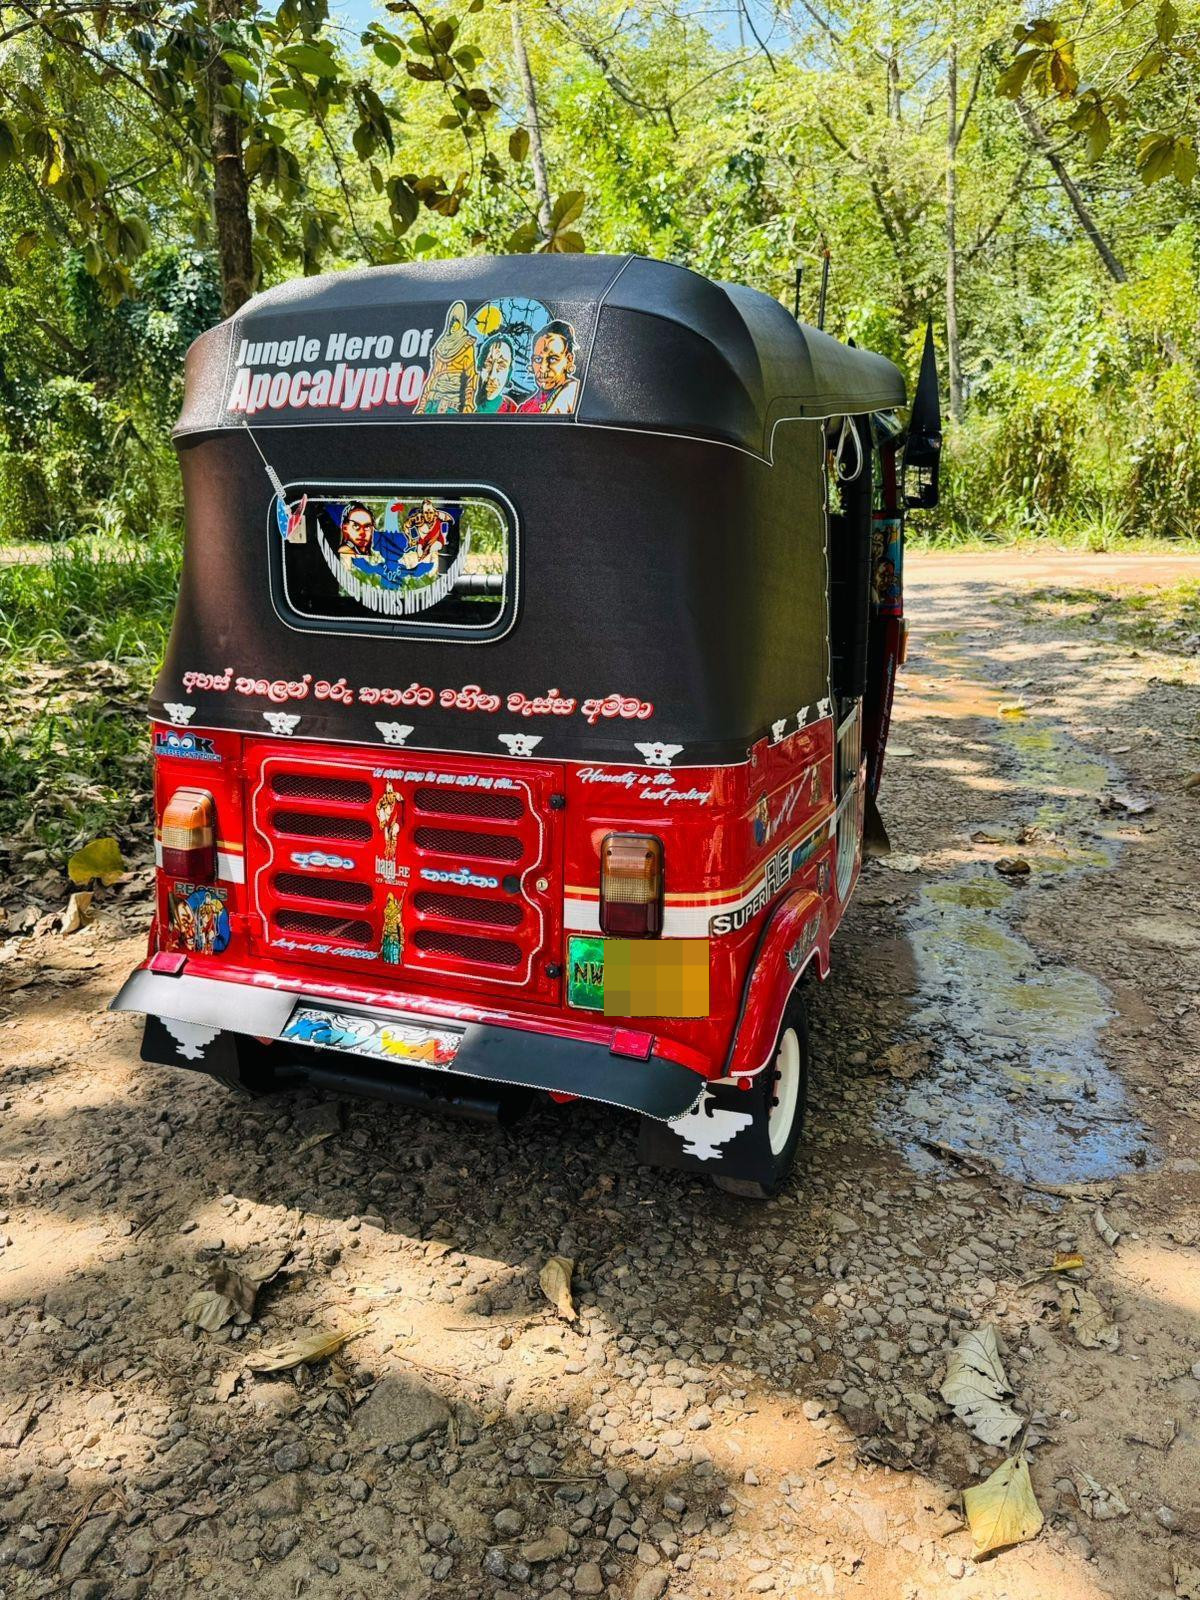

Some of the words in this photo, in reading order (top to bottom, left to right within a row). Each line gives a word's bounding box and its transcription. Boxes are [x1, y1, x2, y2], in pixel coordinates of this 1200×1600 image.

[235, 336, 321, 367] Jungle
[325, 333, 394, 361] Hero
[400, 329, 433, 358] Of
[226, 362, 426, 414] Apocalypto
[362, 583, 403, 615] MOTORS
[182, 667, 234, 694] අහස්
[440, 684, 501, 712] වහින
[507, 688, 576, 716] වැස්ස
[581, 694, 654, 725] අම්මා
[713, 890, 766, 935] SUPER
[765, 844, 791, 904] RE
